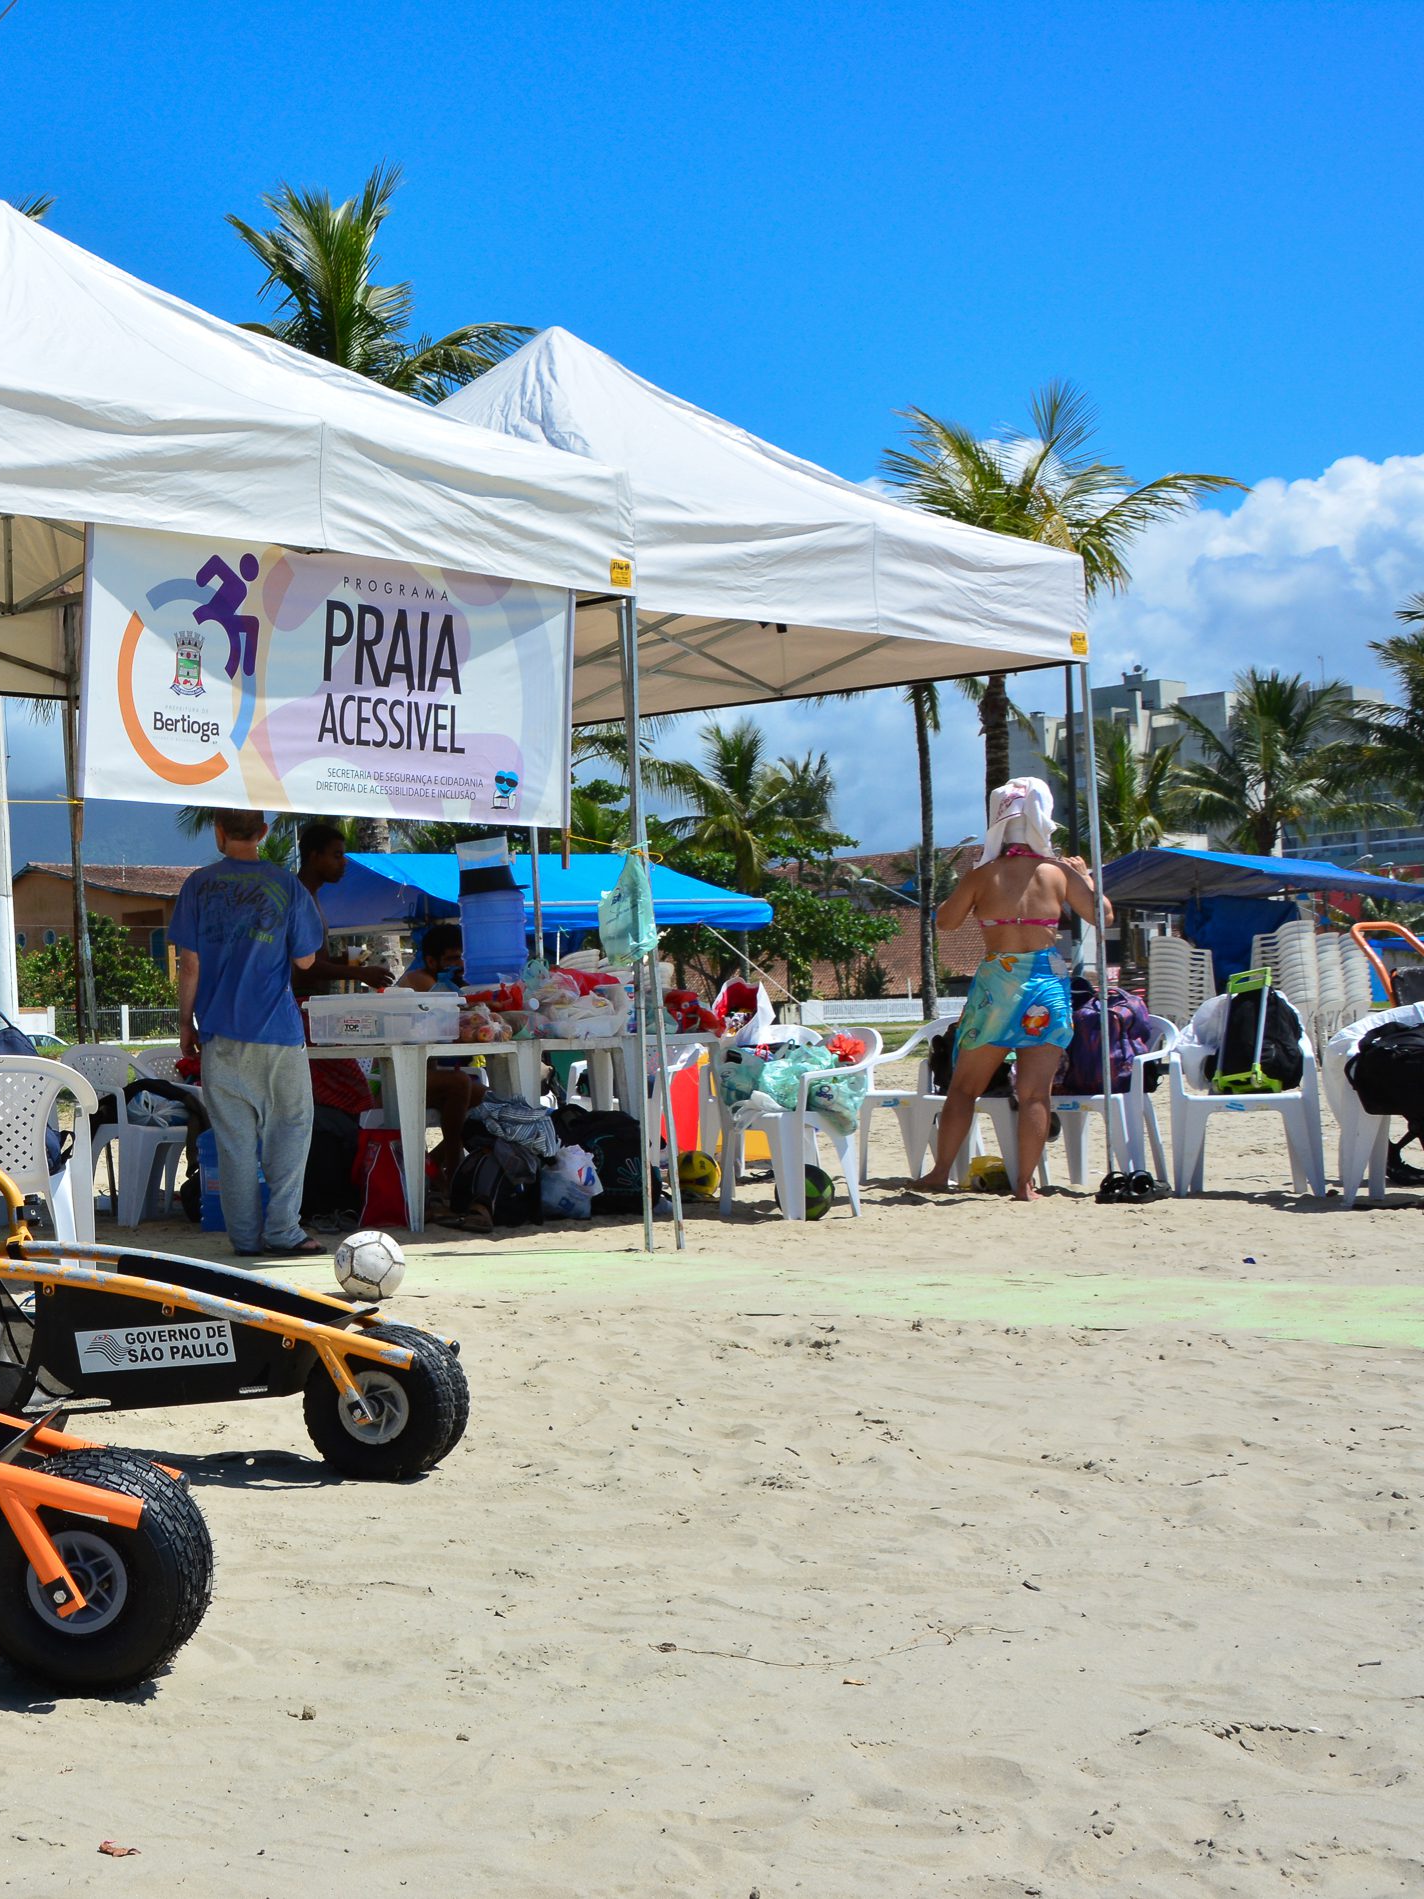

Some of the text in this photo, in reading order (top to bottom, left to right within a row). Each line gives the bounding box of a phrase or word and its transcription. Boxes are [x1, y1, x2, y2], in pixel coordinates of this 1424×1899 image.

[343, 576, 449, 602] PROGRAMA
[323, 599, 462, 695] PRAIA
[153, 711, 220, 743] Bertioga
[318, 688, 465, 755] ACESSÍVEL
[327, 767, 484, 788] SECRETARIA DE SEGURANÇA E CIDADANIA
[315, 780, 476, 801] DIRETORIA DE ACESSIBILIDADE E INCLUSÃO
[125, 1325, 227, 1345] GOVERNO DE
[127, 1341, 229, 1363] SÃO PAULO
